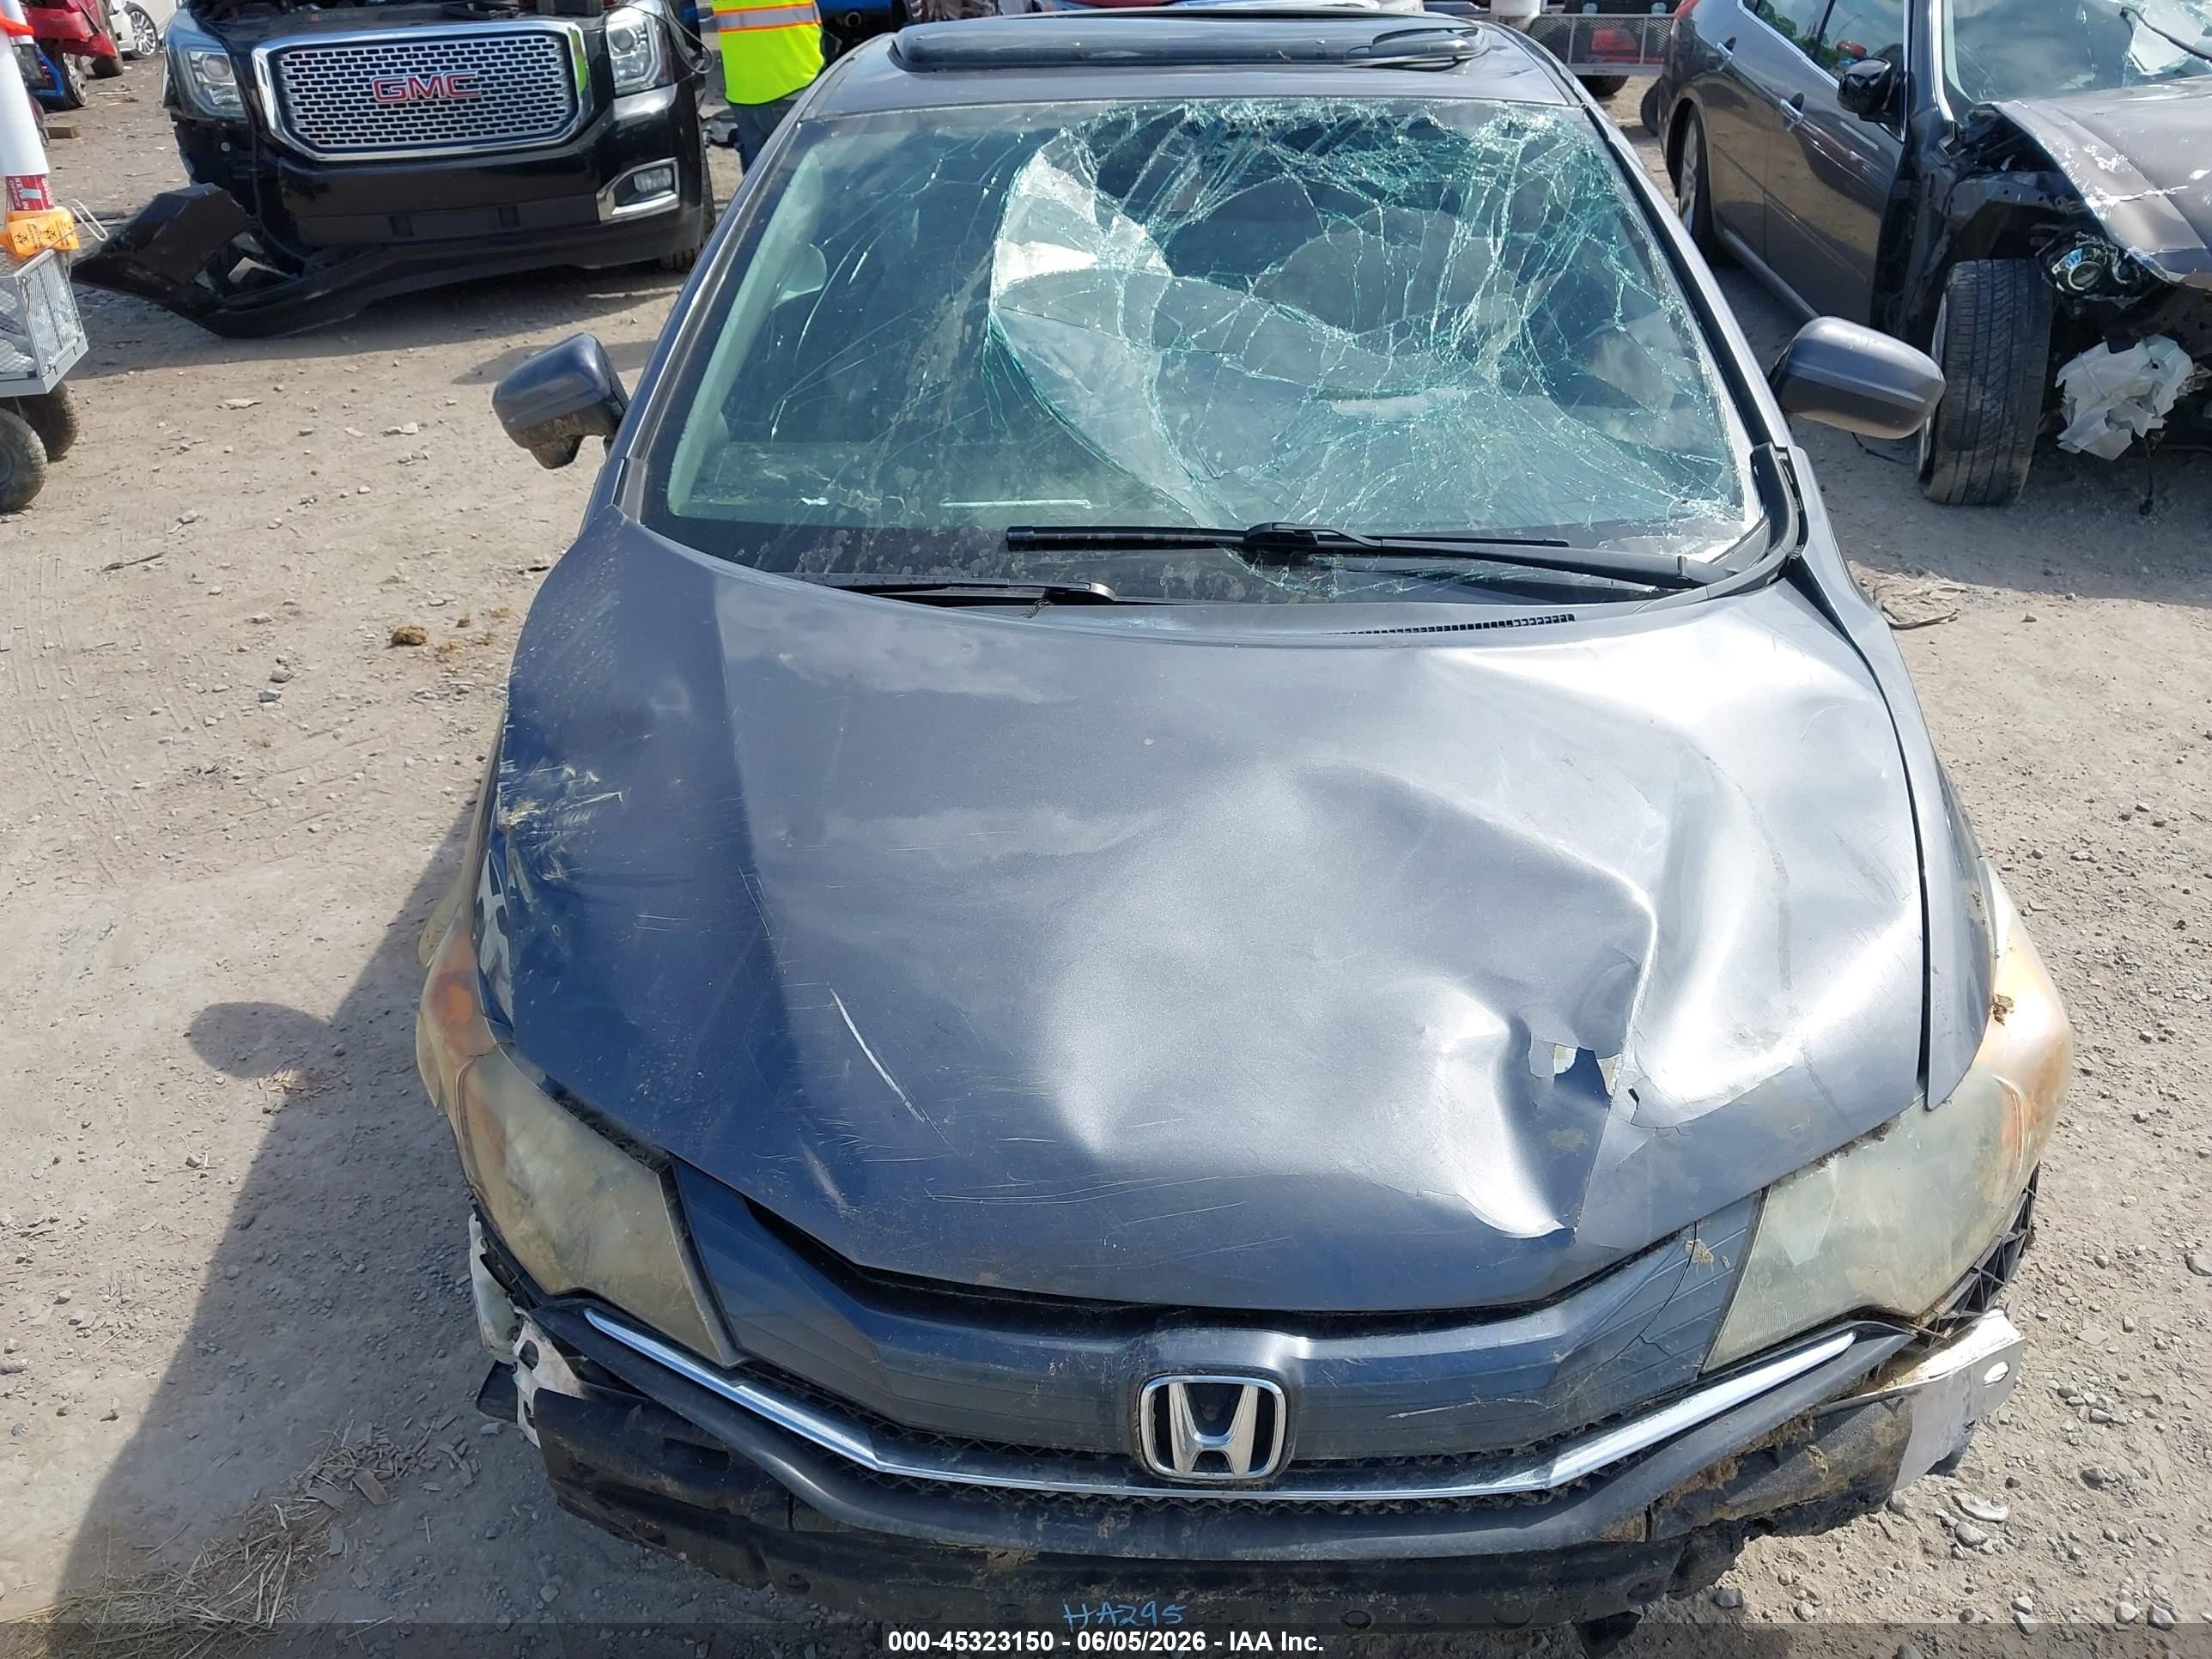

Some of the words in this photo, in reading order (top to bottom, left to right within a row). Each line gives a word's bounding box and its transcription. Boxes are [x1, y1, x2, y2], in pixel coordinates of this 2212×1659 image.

[372, 70, 482, 102] GMC
[9, 179, 21, 208] OFFICE
[22, 200, 29, 210] IN
[1063, 1599, 1187, 1632] HA295
